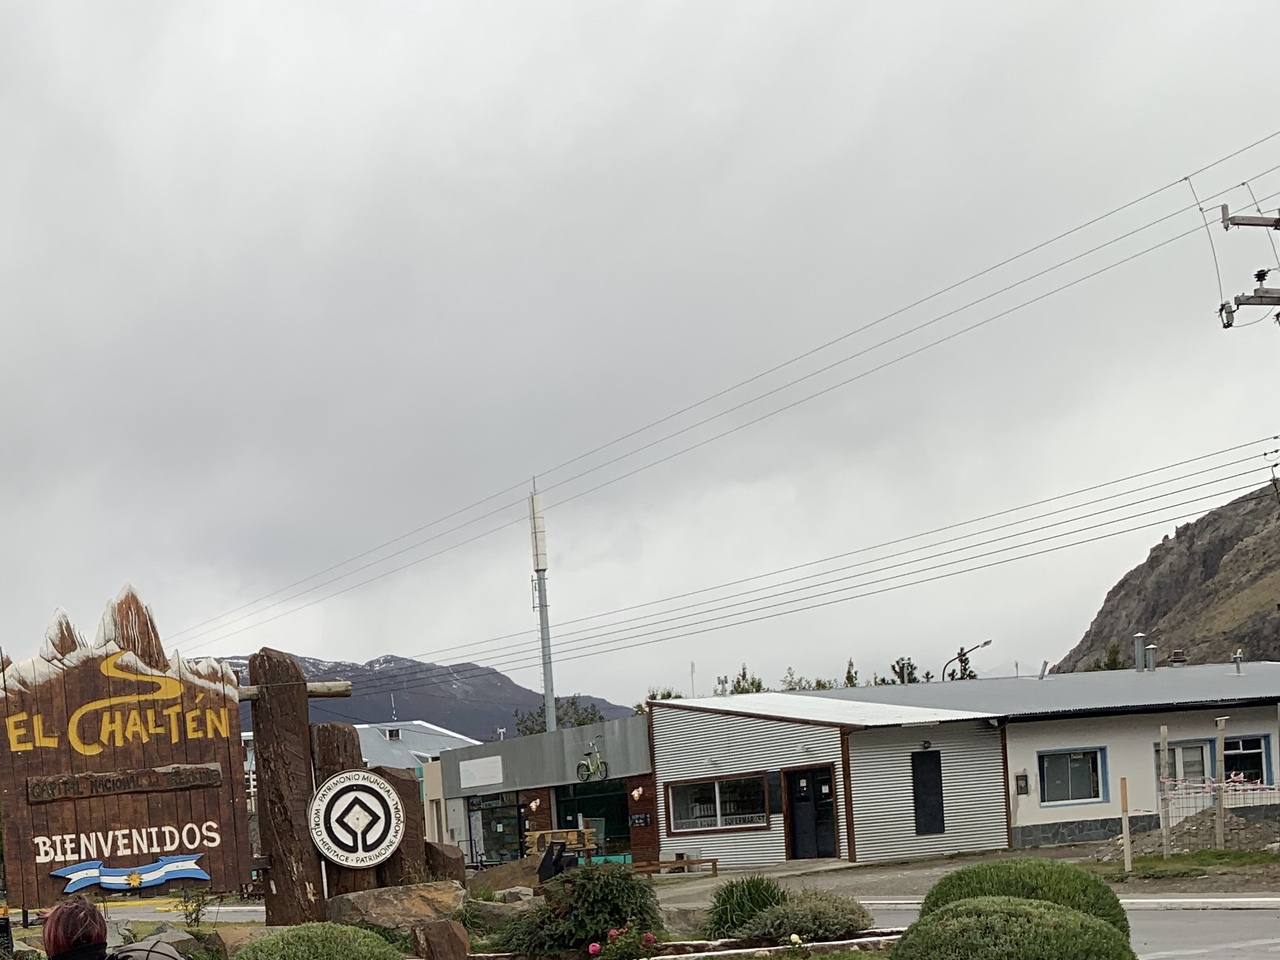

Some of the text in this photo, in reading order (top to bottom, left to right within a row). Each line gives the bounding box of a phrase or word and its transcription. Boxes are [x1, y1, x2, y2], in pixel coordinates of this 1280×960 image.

[5, 693, 231, 756] EL CHALTÉN
[30, 779, 84, 799] CAPITAL
[89, 775, 143, 794] NACIONAL
[319, 773, 392, 803] PATRIMONIO MUNDIAL
[32, 821, 221, 863] BIENVENIDOS
[313, 800, 402, 864] WORLD HERITAGE PATRIMOINE MONDIAL
